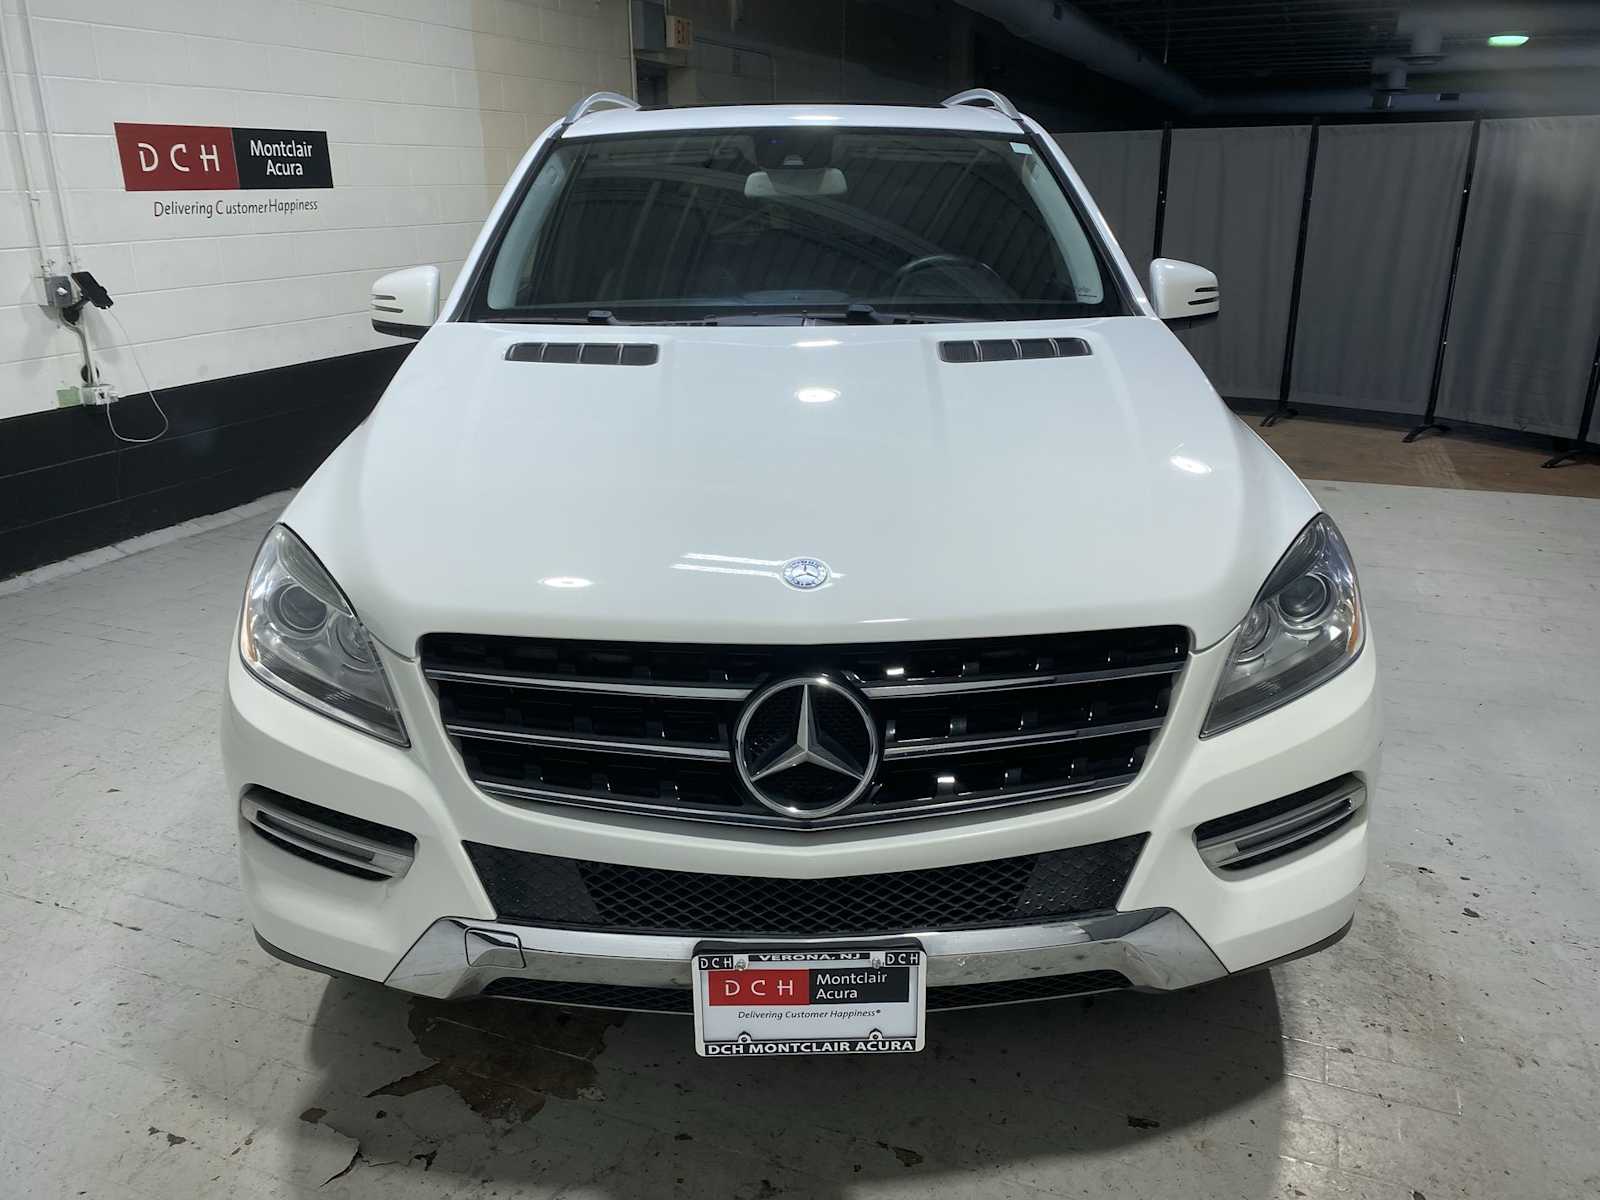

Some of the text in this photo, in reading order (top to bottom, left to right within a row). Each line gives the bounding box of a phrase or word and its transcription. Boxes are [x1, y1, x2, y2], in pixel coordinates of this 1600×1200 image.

[250, 140, 313, 158] Montclair
[266, 159, 304, 176] Acura
[153, 201, 213, 218] Delivering
[700, 957, 732, 969] DCH
[759, 952, 861, 961] VERONA, NJ
[887, 953, 919, 965] DCH
[816, 971, 888, 986] Montclair
[725, 979, 793, 996] DCH
[816, 988, 858, 1000] Acura
[738, 1011, 783, 1020] Delivering
[785, 1009, 828, 1019] Customer
[708, 1040, 914, 1055] DCH MONTCLAIR ACURA
